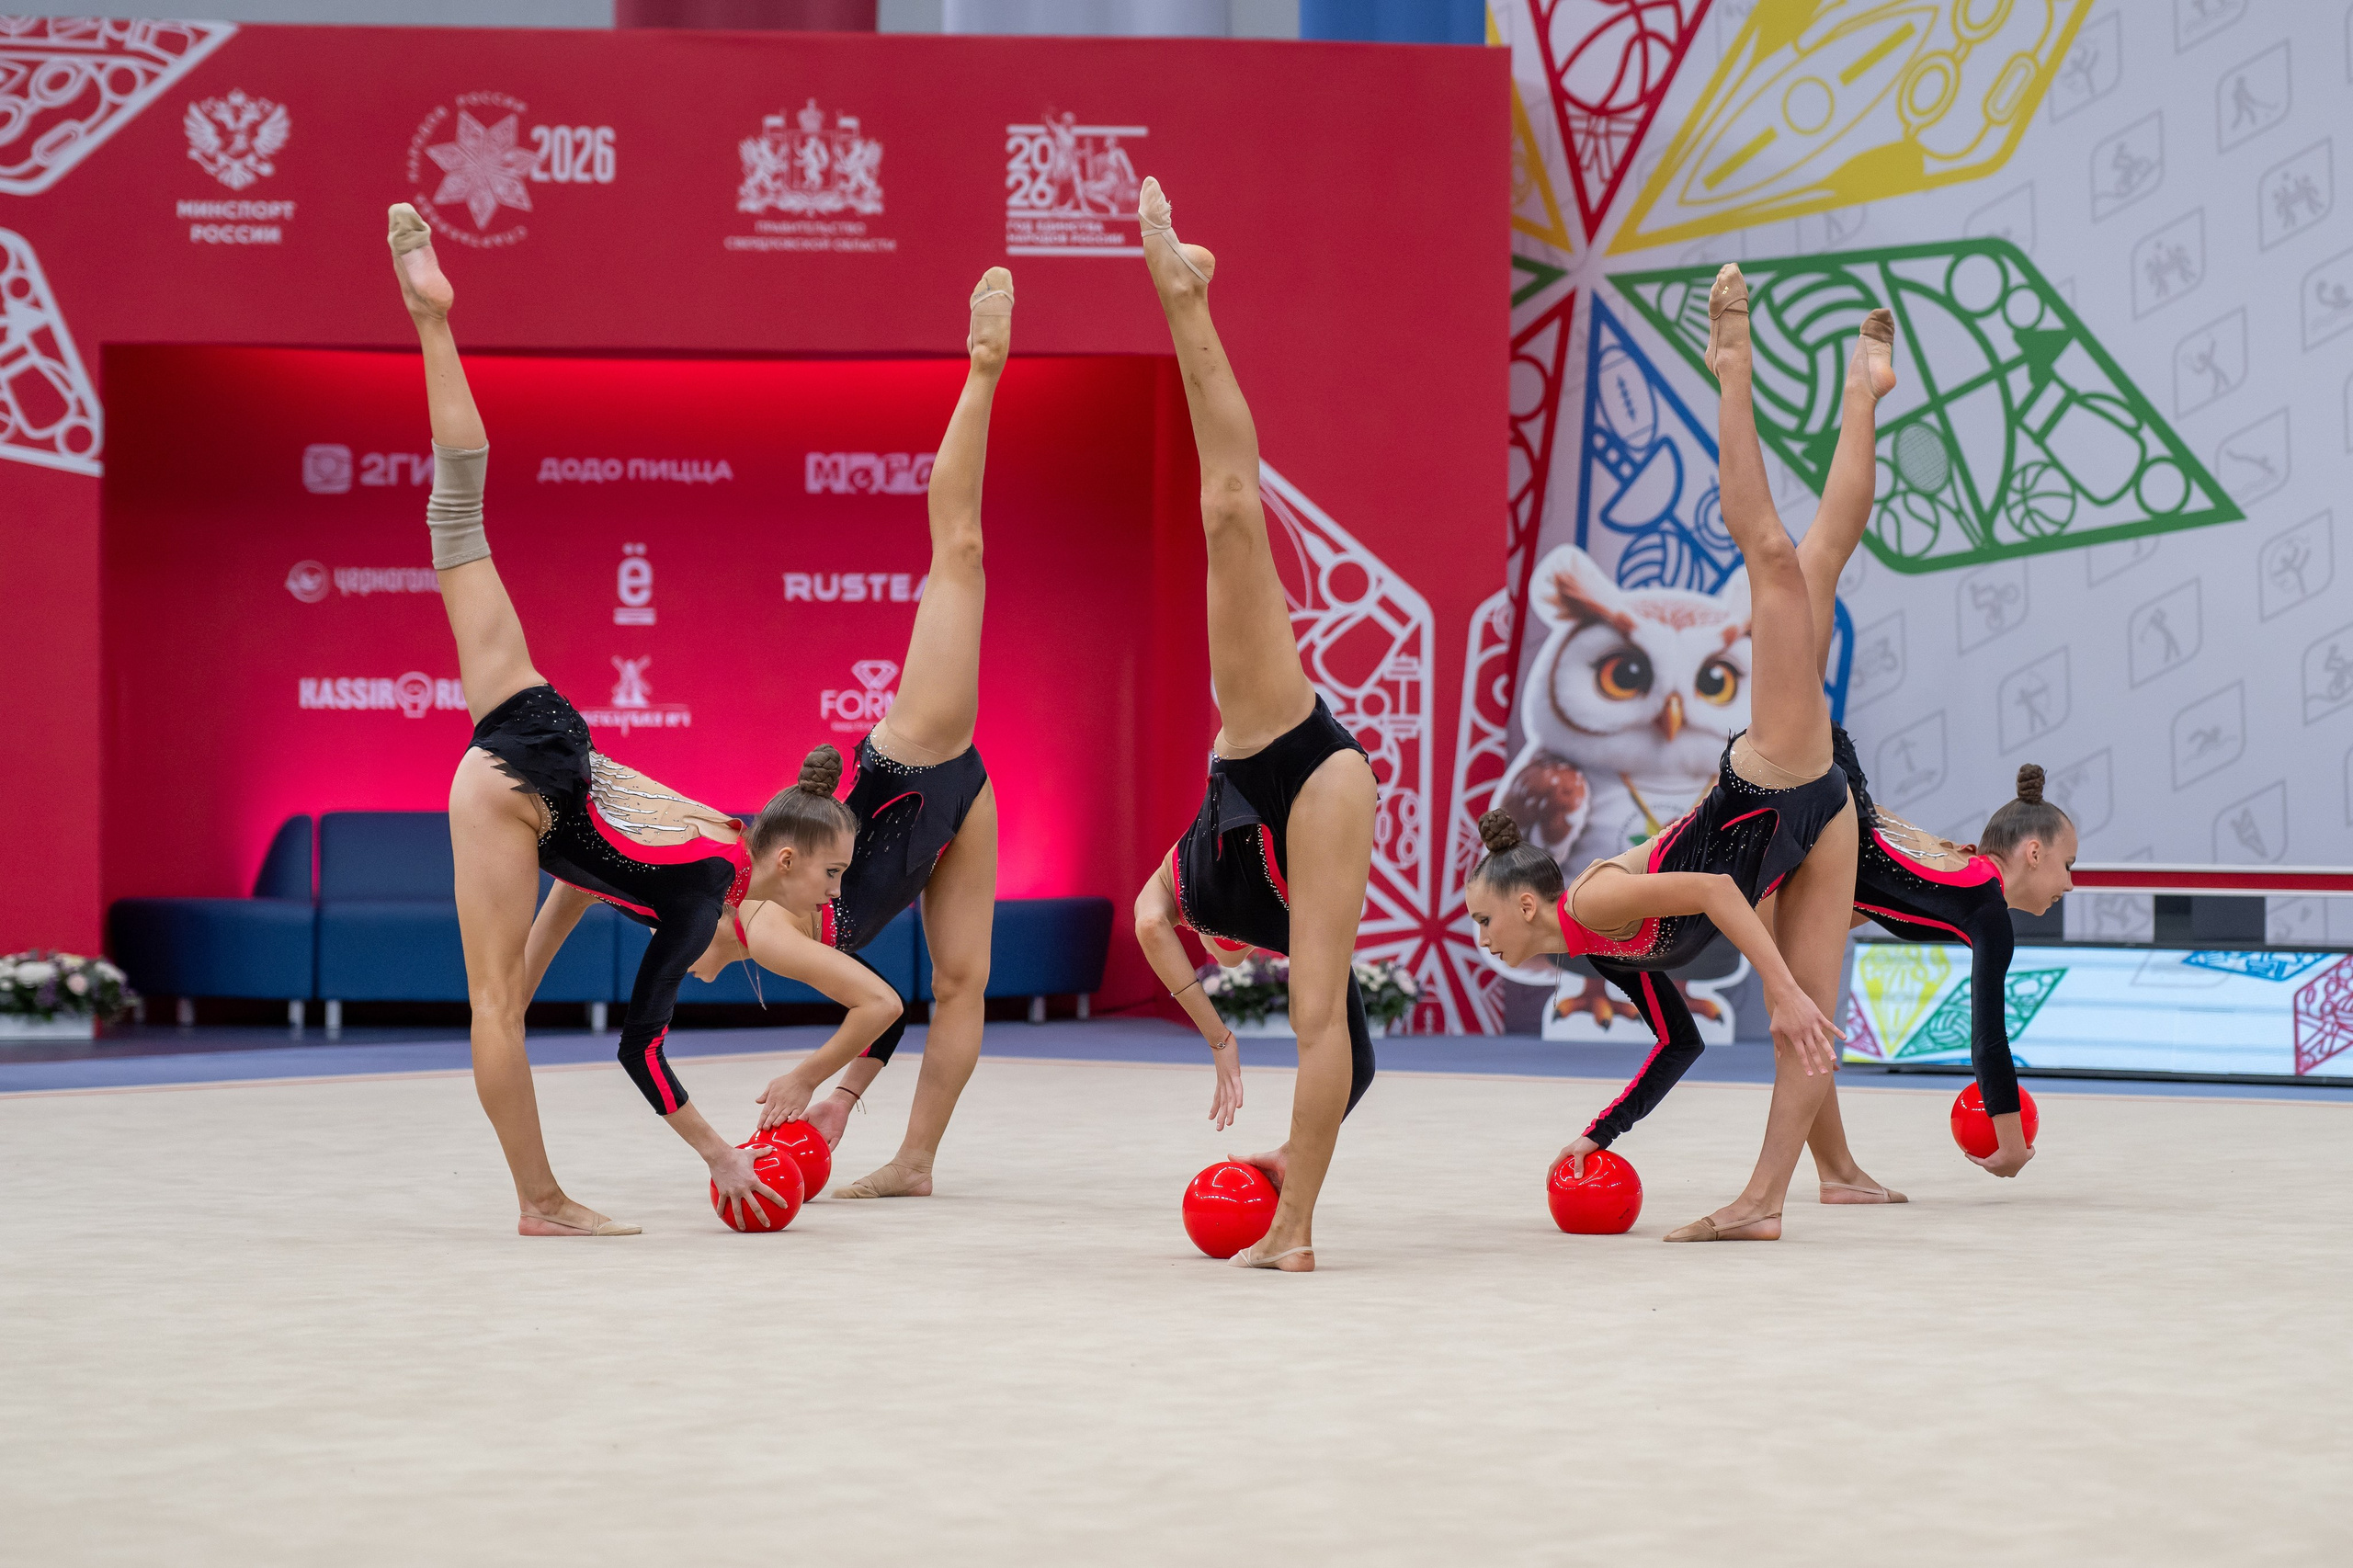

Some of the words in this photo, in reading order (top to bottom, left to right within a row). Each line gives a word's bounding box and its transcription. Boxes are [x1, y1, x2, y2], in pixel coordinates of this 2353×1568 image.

[530, 125, 615, 182] 2026
[176, 199, 296, 220] МИНСПОРТ
[189, 224, 281, 244] РОССИИ
[538, 458, 622, 484] ДОДО
[628, 459, 733, 485] ПИЦЦА
